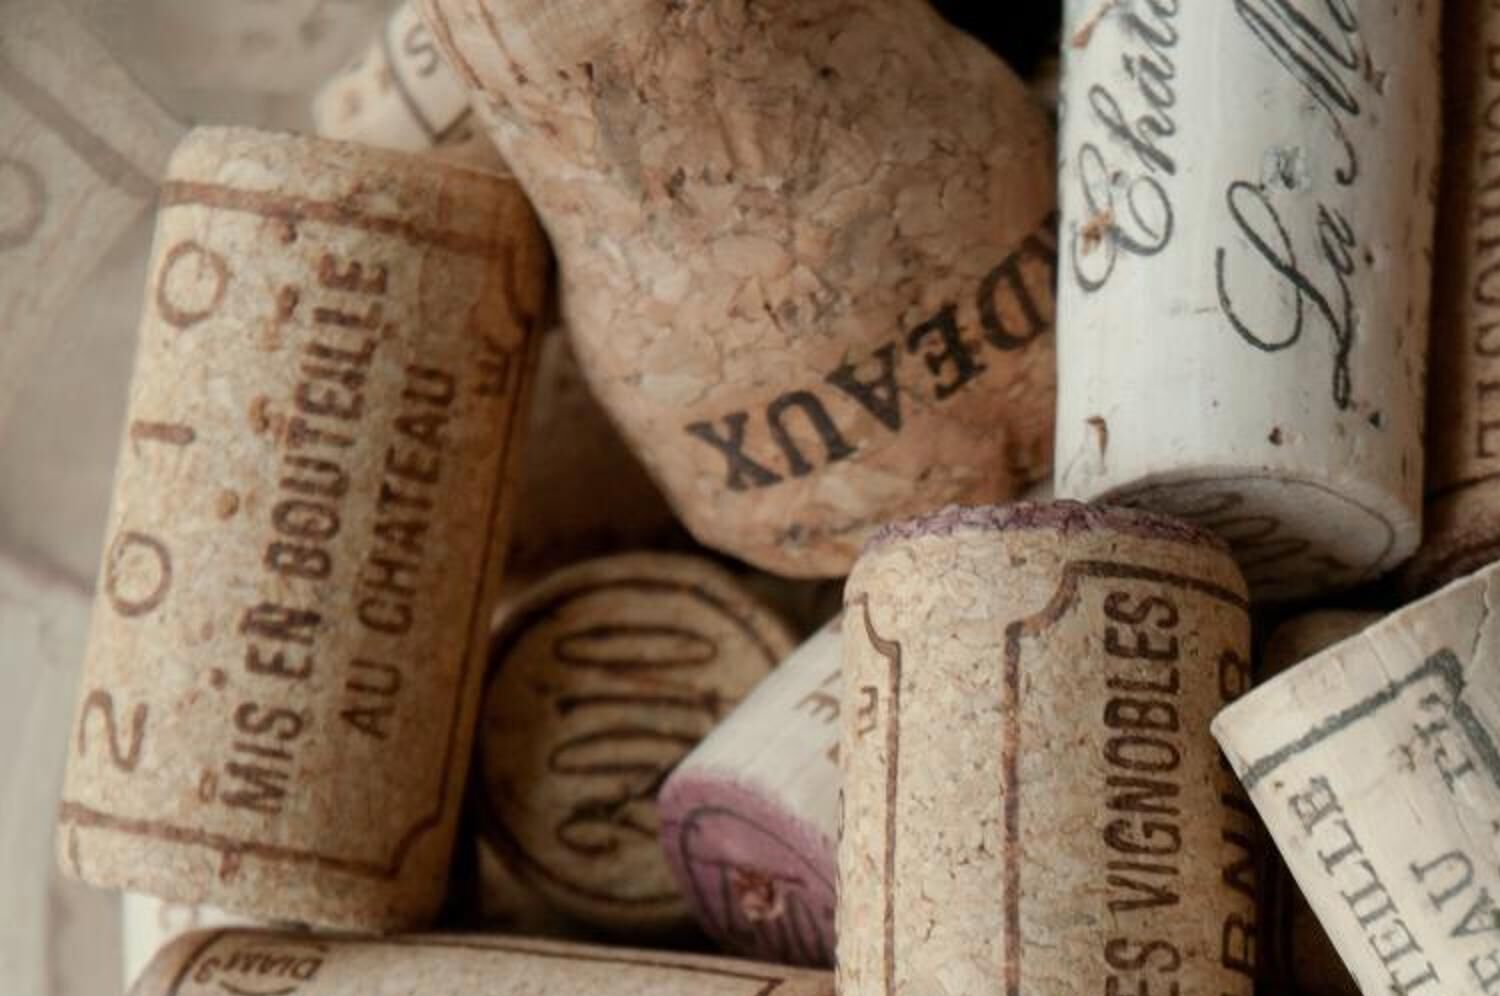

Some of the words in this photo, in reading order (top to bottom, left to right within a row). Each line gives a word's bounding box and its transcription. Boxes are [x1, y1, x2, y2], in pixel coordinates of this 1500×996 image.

[262, 252, 390, 584] BOUTEILLE
[684, 220, 1058, 494] DEAUX
[1217, 180, 1358, 411] La
[356, 364, 457, 636] CHATEAU
[222, 698, 304, 816] MIS
[238, 598, 323, 683] EN
[338, 648, 402, 742] AU
[1103, 590, 1184, 916] VIGNOBLES
